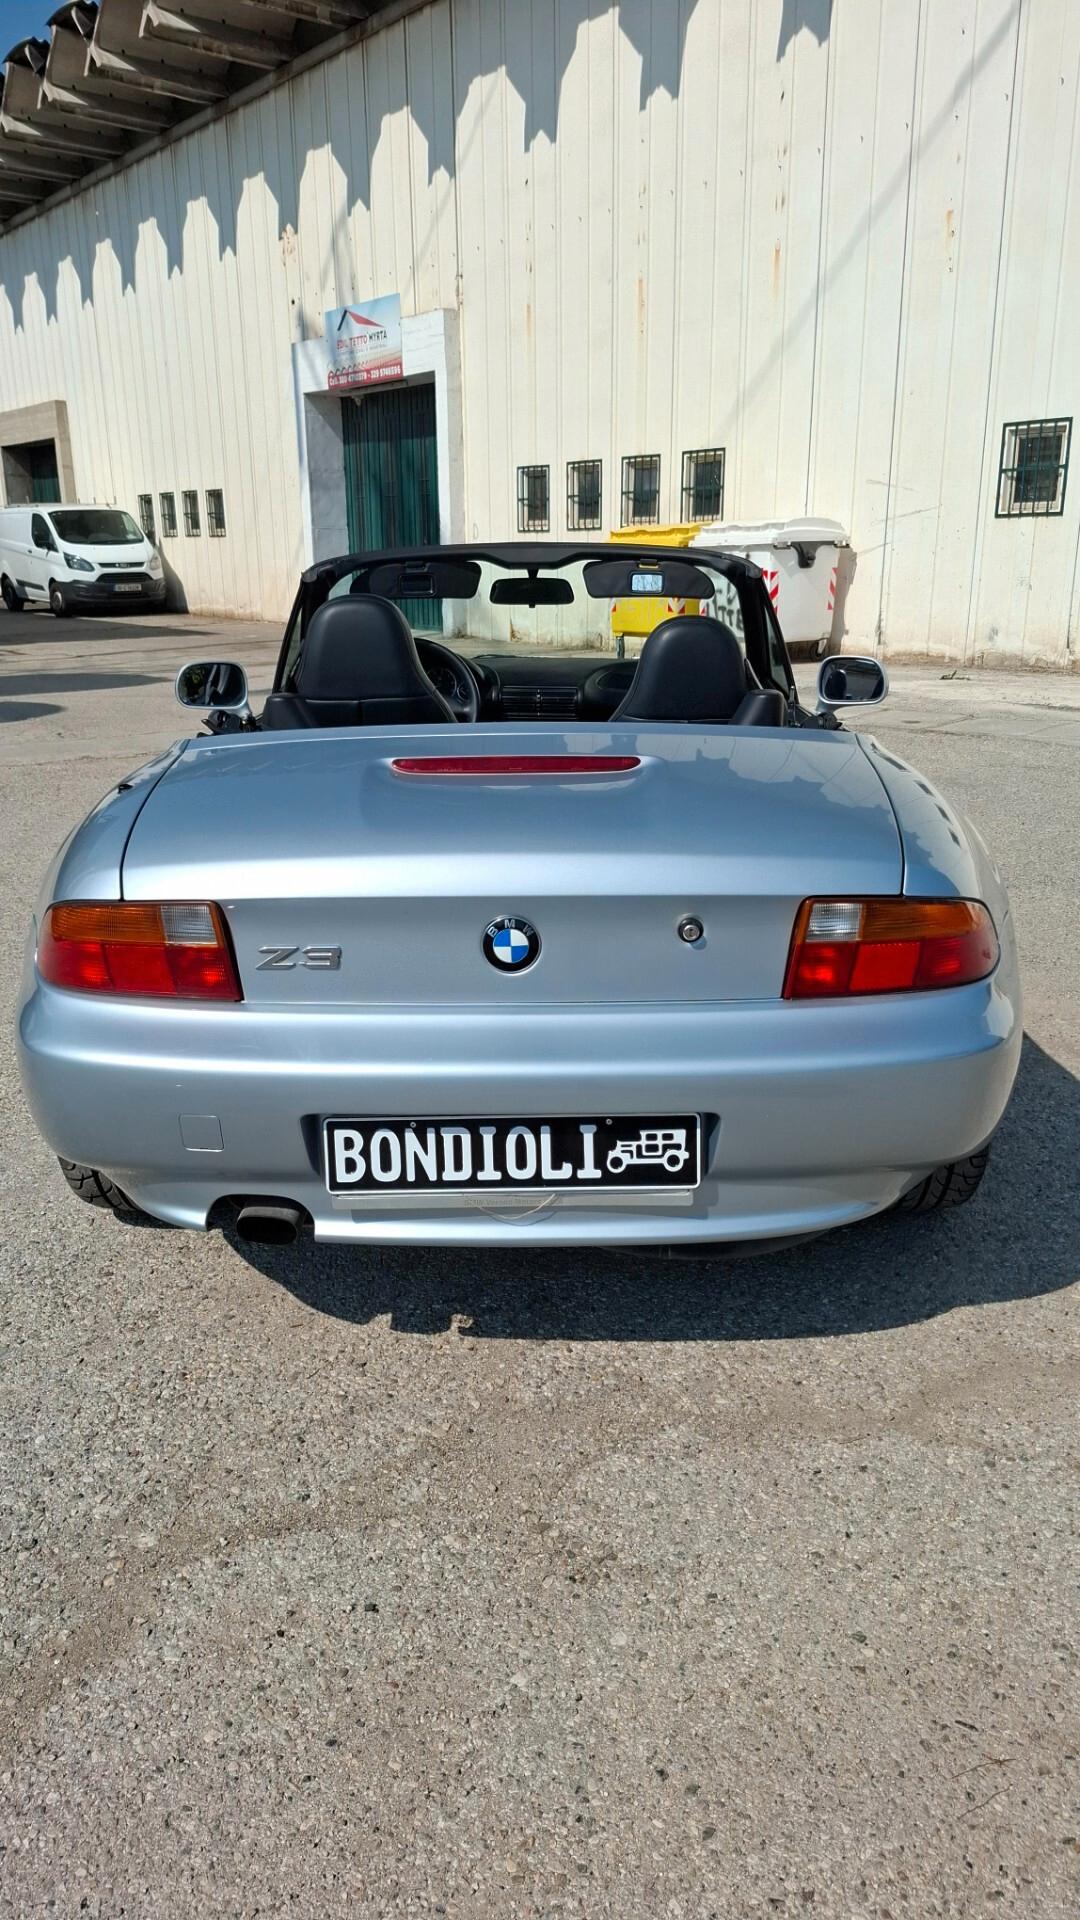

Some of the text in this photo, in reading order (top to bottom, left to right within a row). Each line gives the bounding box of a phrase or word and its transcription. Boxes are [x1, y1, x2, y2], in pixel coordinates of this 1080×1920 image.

[349, 335, 368, 348] TETTO
[487, 919, 534, 938] BMW
[255, 946, 342, 971] Z3
[333, 1124, 602, 1183] BONDIOLI
